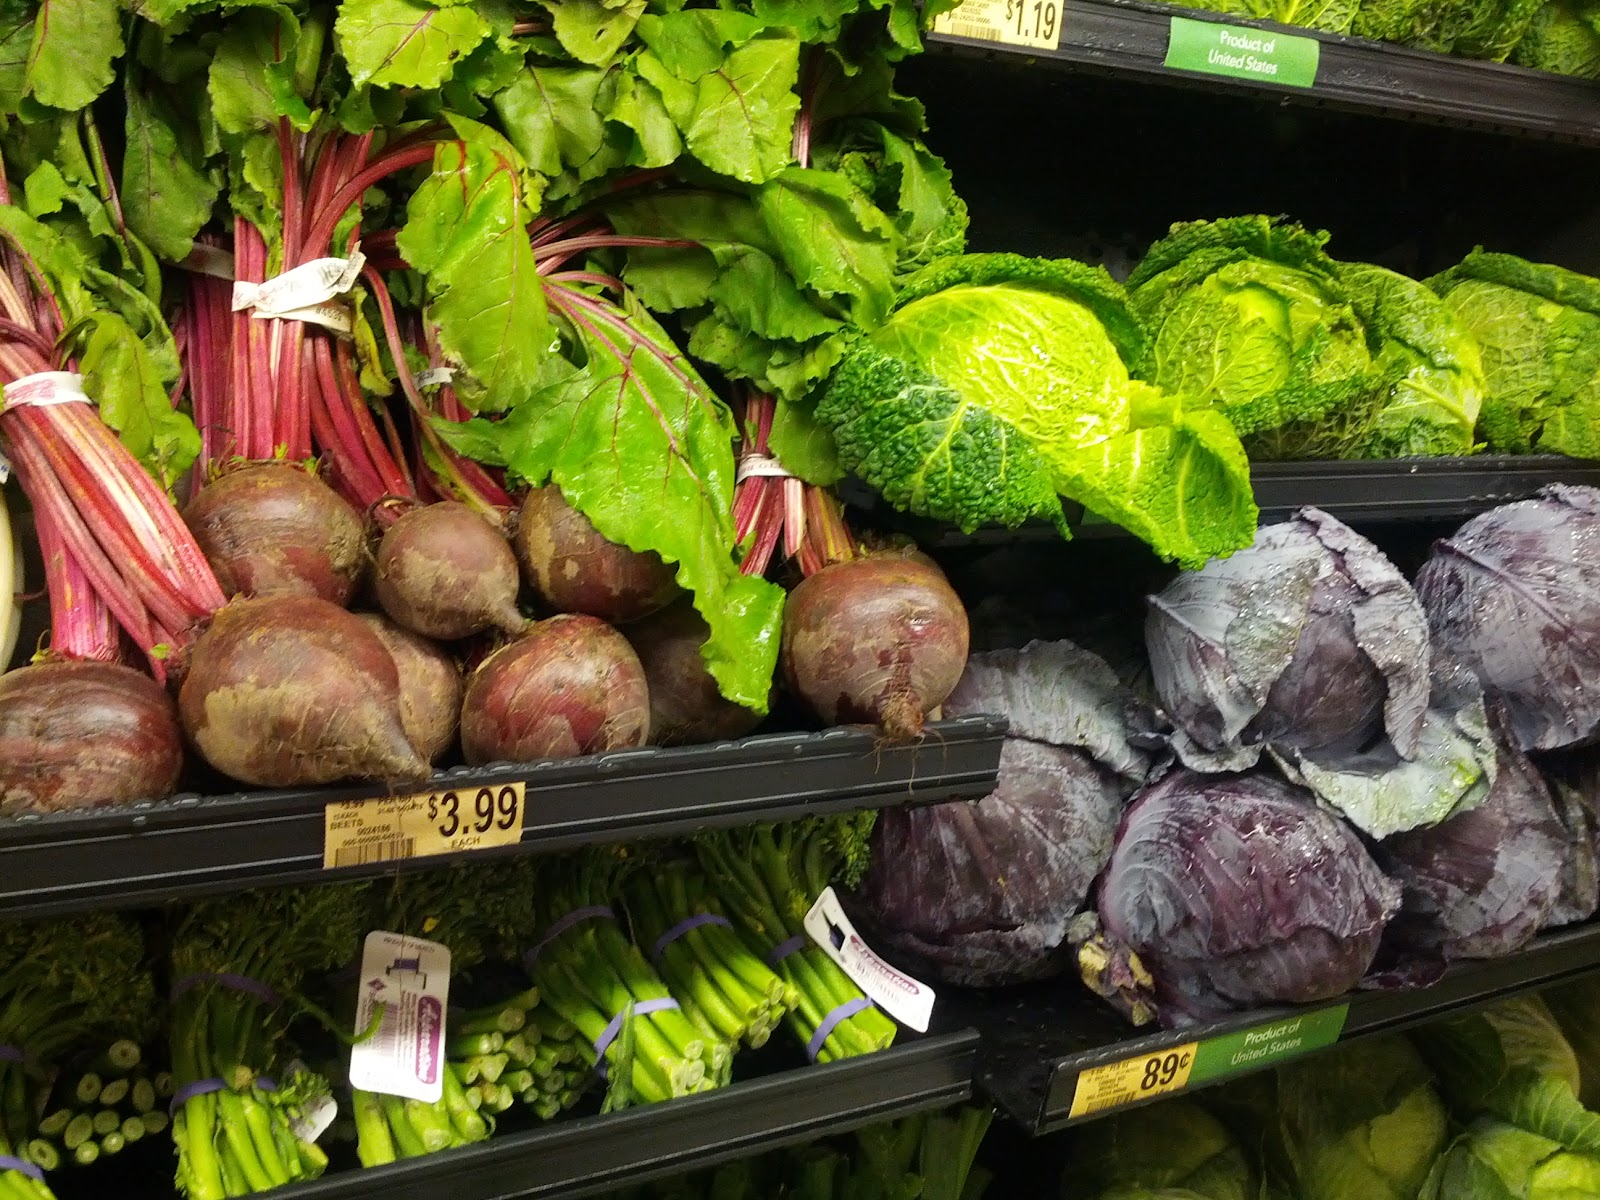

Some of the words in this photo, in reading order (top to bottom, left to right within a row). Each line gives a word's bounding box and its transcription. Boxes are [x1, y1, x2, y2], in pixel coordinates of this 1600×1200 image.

[1005, 0, 1056, 41] $1.19
[1220, 30, 1262, 52] Product
[1263, 38, 1276, 54] of
[1208, 49, 1245, 69] United
[1245, 56, 1278, 75] States
[330, 819, 364, 831] BEETS
[427, 785, 518, 838] $3.99
[451, 836, 480, 849] EACH
[1244, 1027, 1286, 1047] Product
[1286, 1020, 1301, 1036] of
[1231, 1046, 1268, 1066] United
[1269, 1037, 1302, 1056] States
[1140, 1051, 1191, 1091] 89¢
